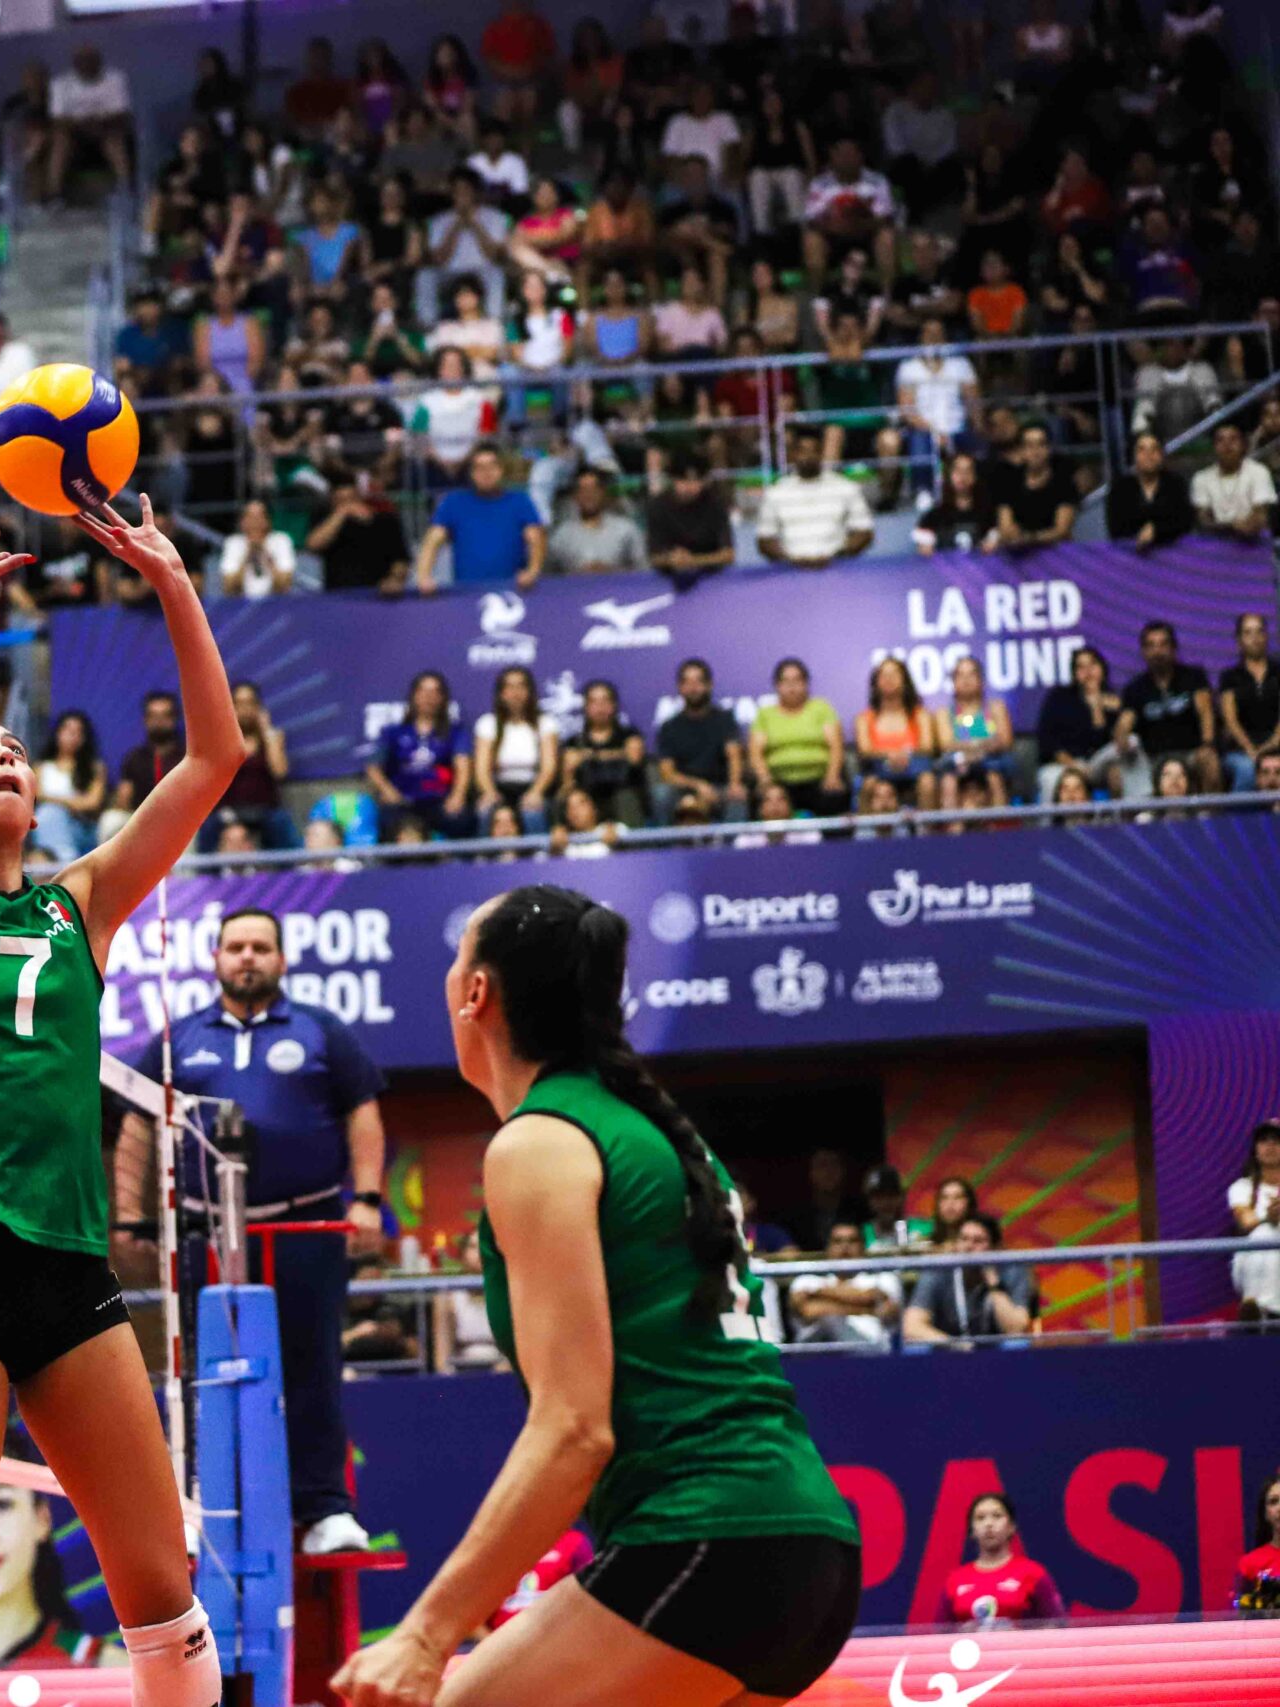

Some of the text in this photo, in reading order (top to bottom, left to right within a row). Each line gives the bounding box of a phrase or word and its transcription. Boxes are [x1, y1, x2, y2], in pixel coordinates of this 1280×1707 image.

[908, 579, 1083, 638] LA RED
[283, 908, 393, 968] POR
[704, 894, 839, 931] Deporte
[100, 969, 396, 1037] L VOBOL
[645, 977, 729, 1009] CODE
